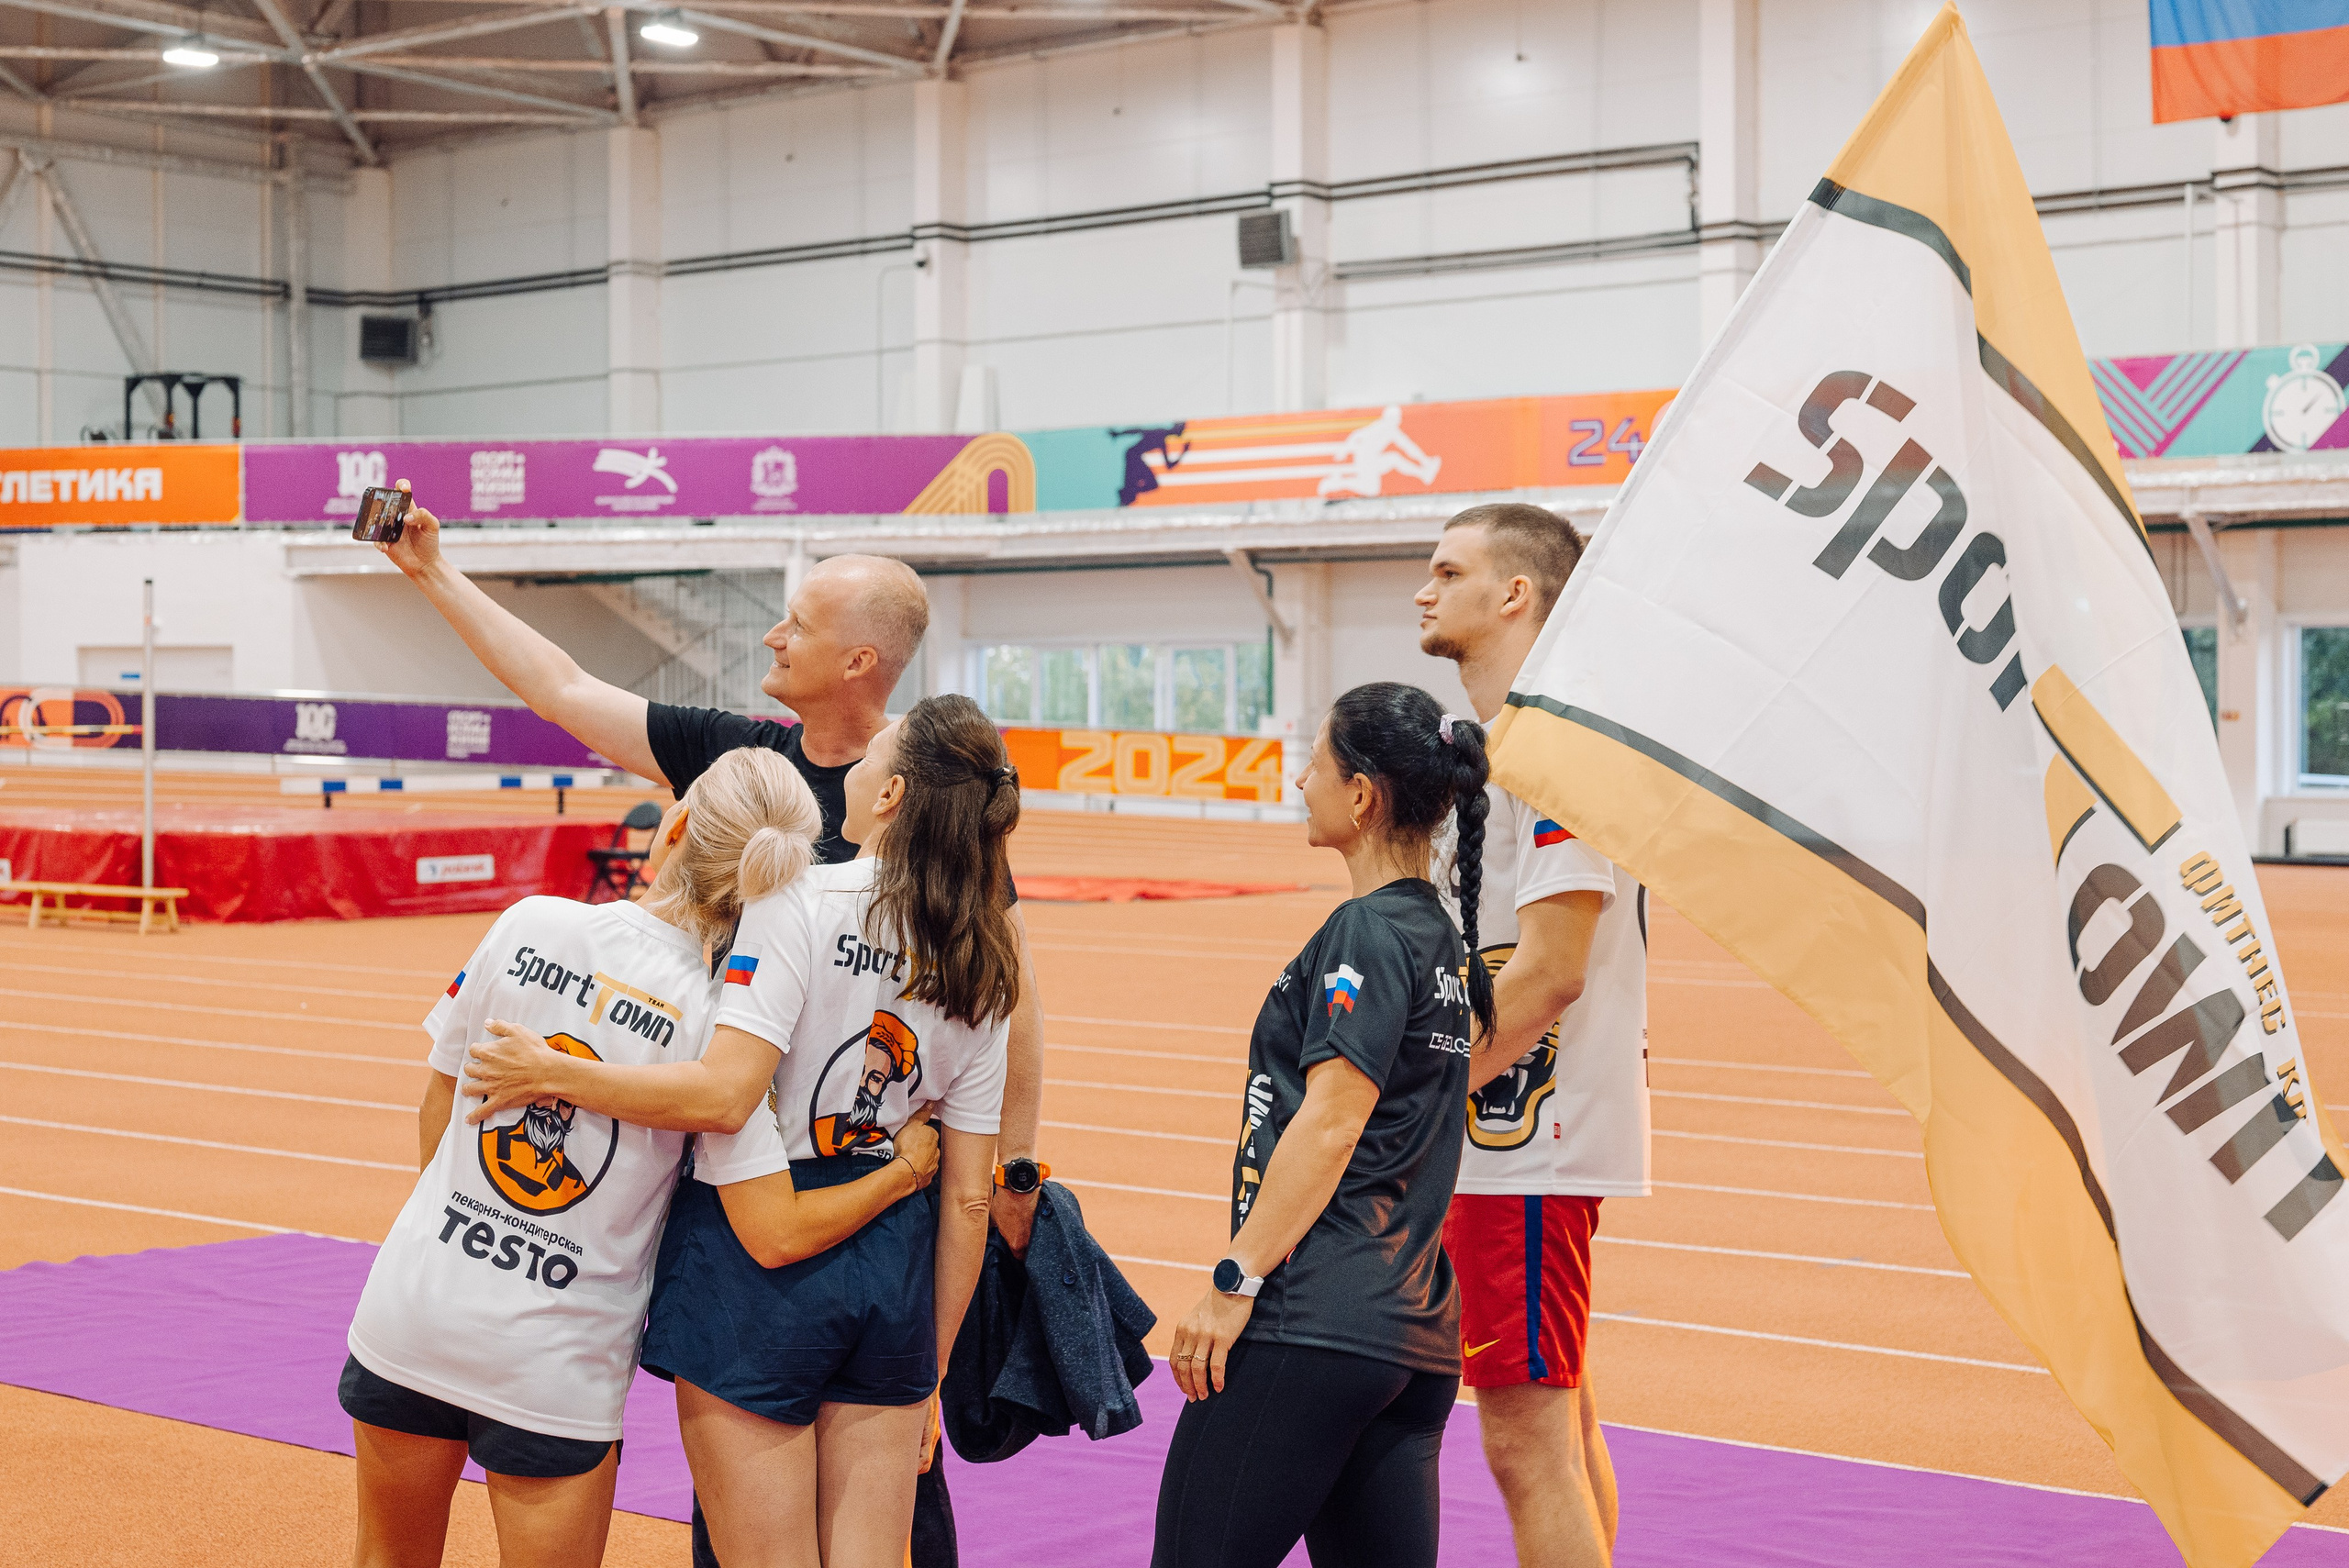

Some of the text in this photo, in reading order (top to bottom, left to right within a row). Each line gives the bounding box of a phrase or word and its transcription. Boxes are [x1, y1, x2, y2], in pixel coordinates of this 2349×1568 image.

[1567, 417, 1647, 466] 24
[0, 468, 163, 504] ЛЕТИКА
[1056, 729, 1282, 803] 2024
[2180, 851, 2286, 1036] ФИТНЕС
[648, 997, 665, 1008] TEAM
[451, 1190, 584, 1257] пекарня-кондитерская
